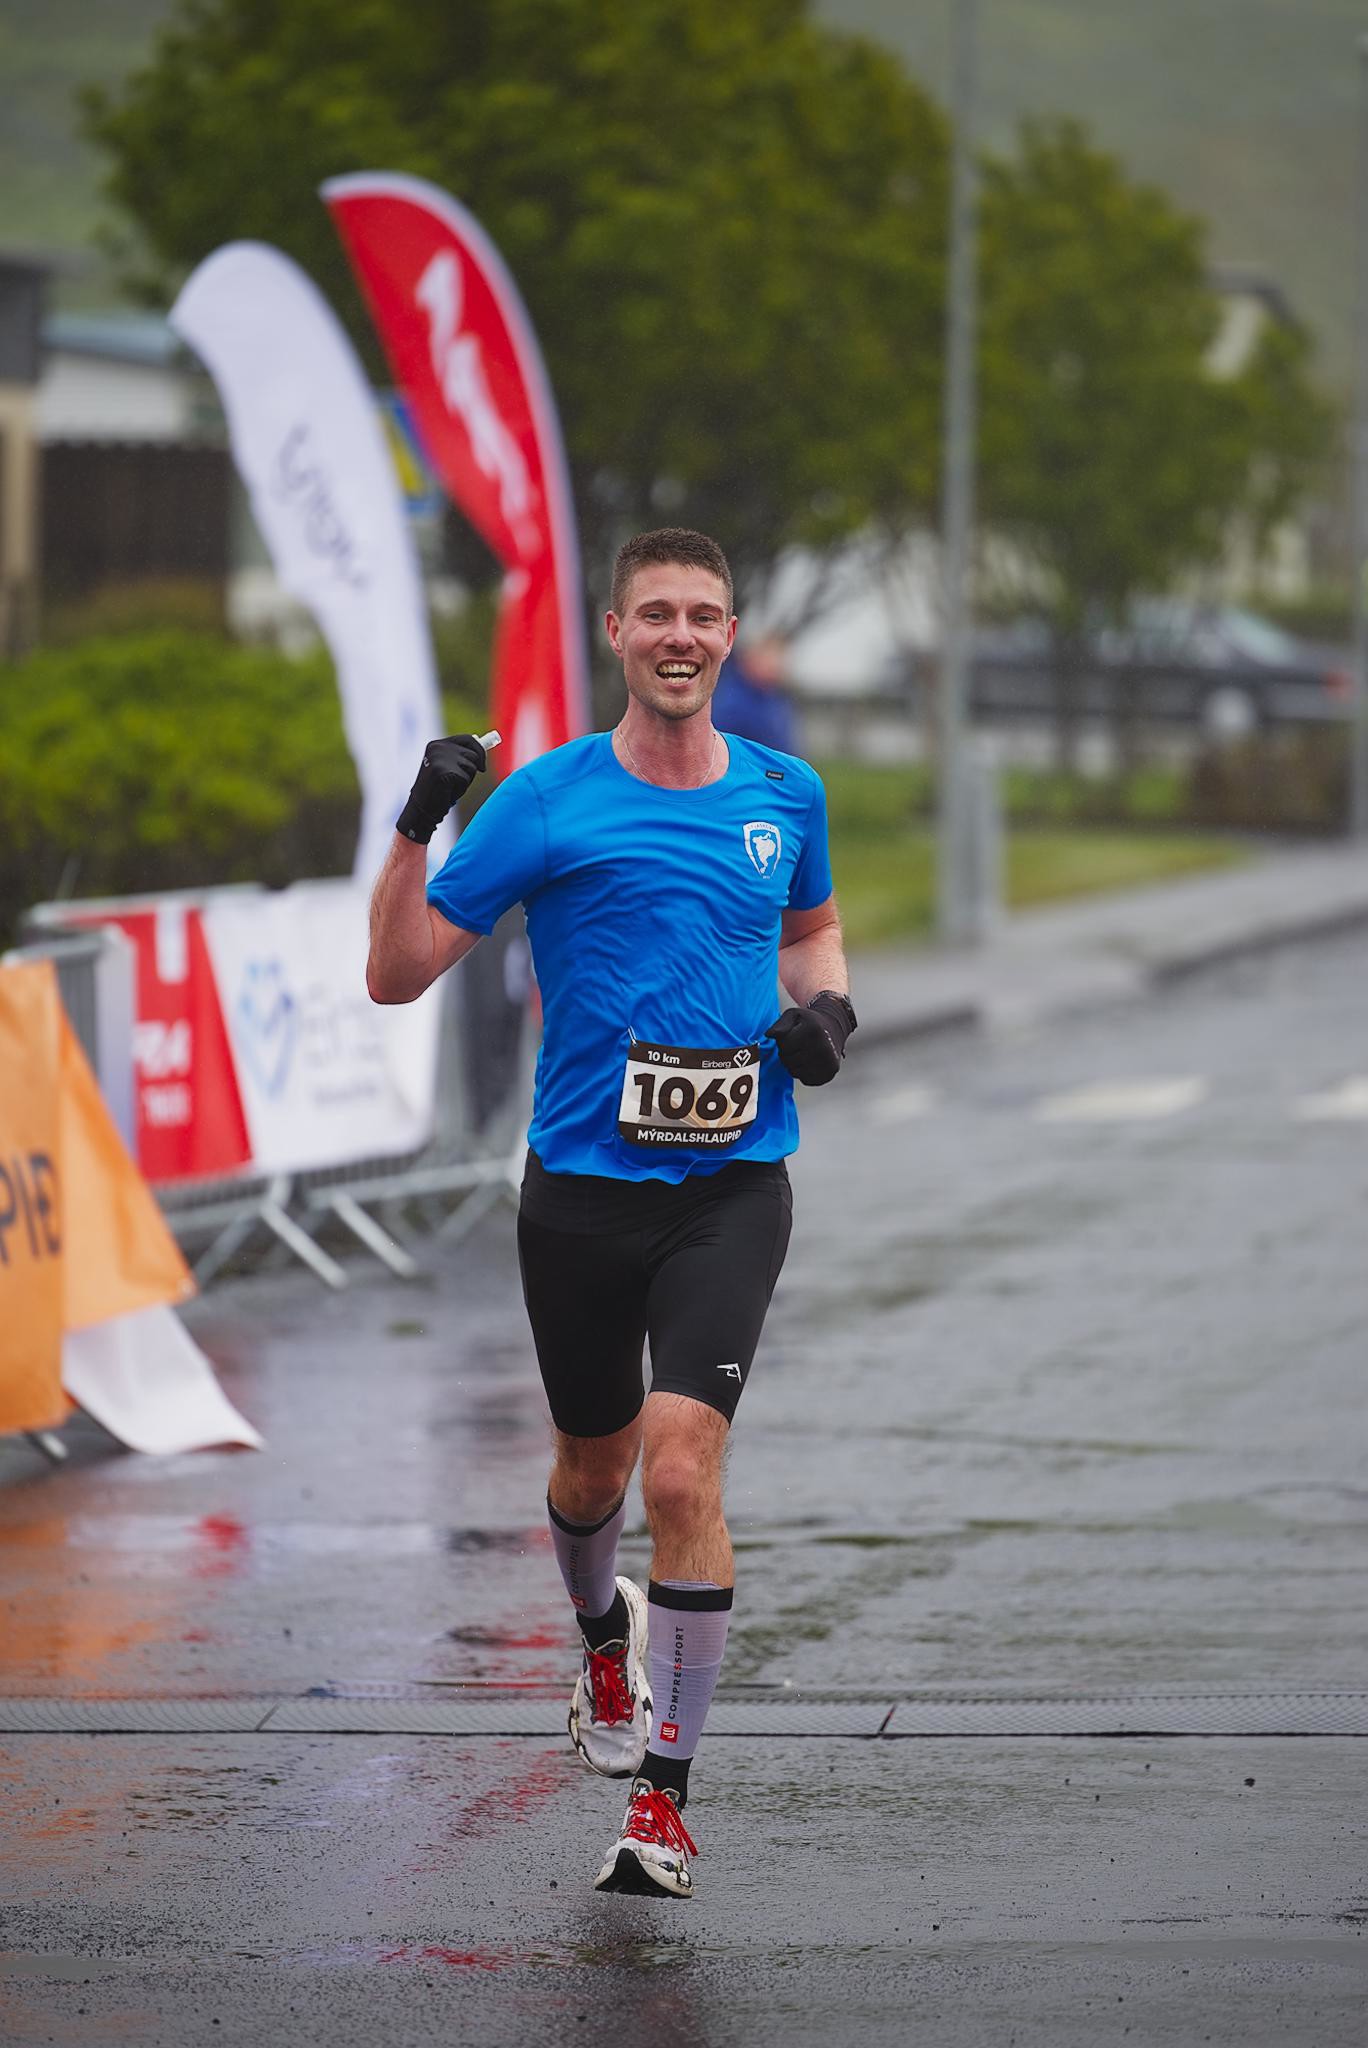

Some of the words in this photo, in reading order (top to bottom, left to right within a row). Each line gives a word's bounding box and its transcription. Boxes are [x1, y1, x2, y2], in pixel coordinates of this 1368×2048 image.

[647, 1050, 660, 1062] 10
[662, 1053, 680, 1065] km
[701, 1060, 732, 1069] Eirberg
[633, 1072, 753, 1120] 1069
[668, 1626, 684, 1720] COMPRESSPORT
